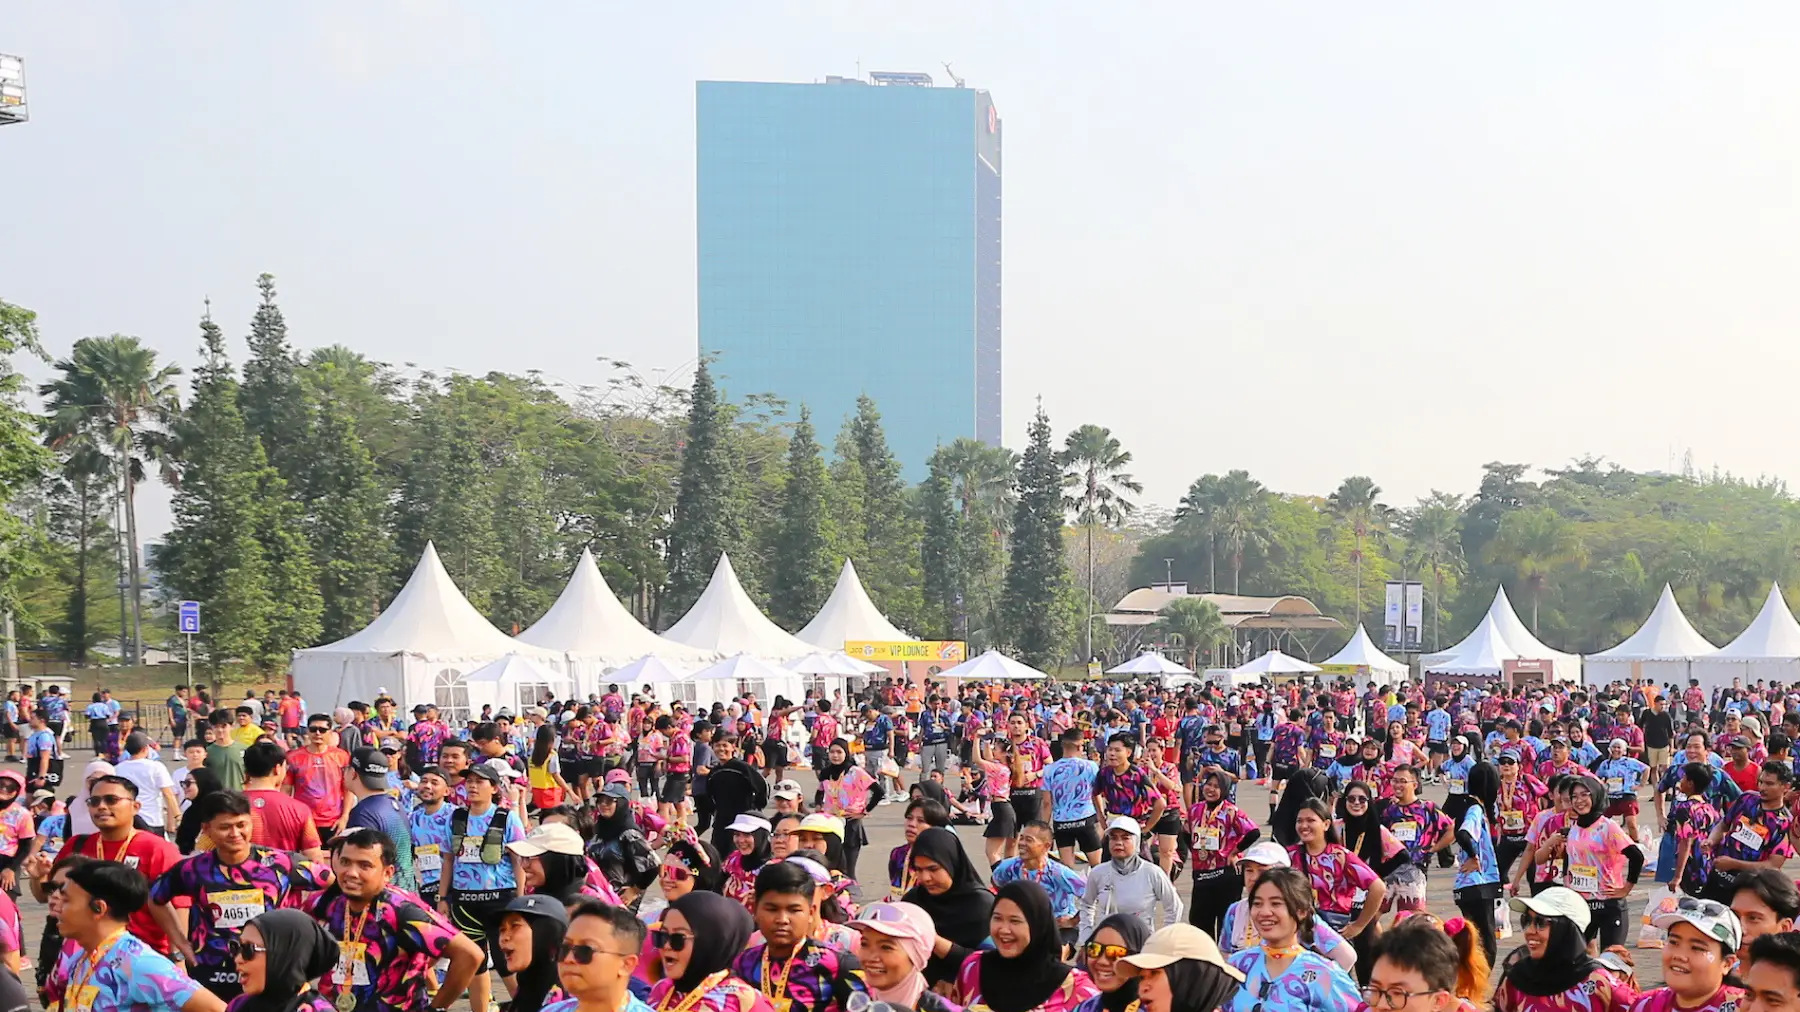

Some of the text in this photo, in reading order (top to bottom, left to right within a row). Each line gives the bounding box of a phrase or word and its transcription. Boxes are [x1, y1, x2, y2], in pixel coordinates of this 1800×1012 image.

[890, 645, 901, 656] VIP
[902, 645, 929, 656] LOUNGE
[465, 848, 480, 857] 540
[459, 892, 500, 902] JCORUN
[224, 907, 250, 920] 4051
[209, 972, 241, 983] JCO
